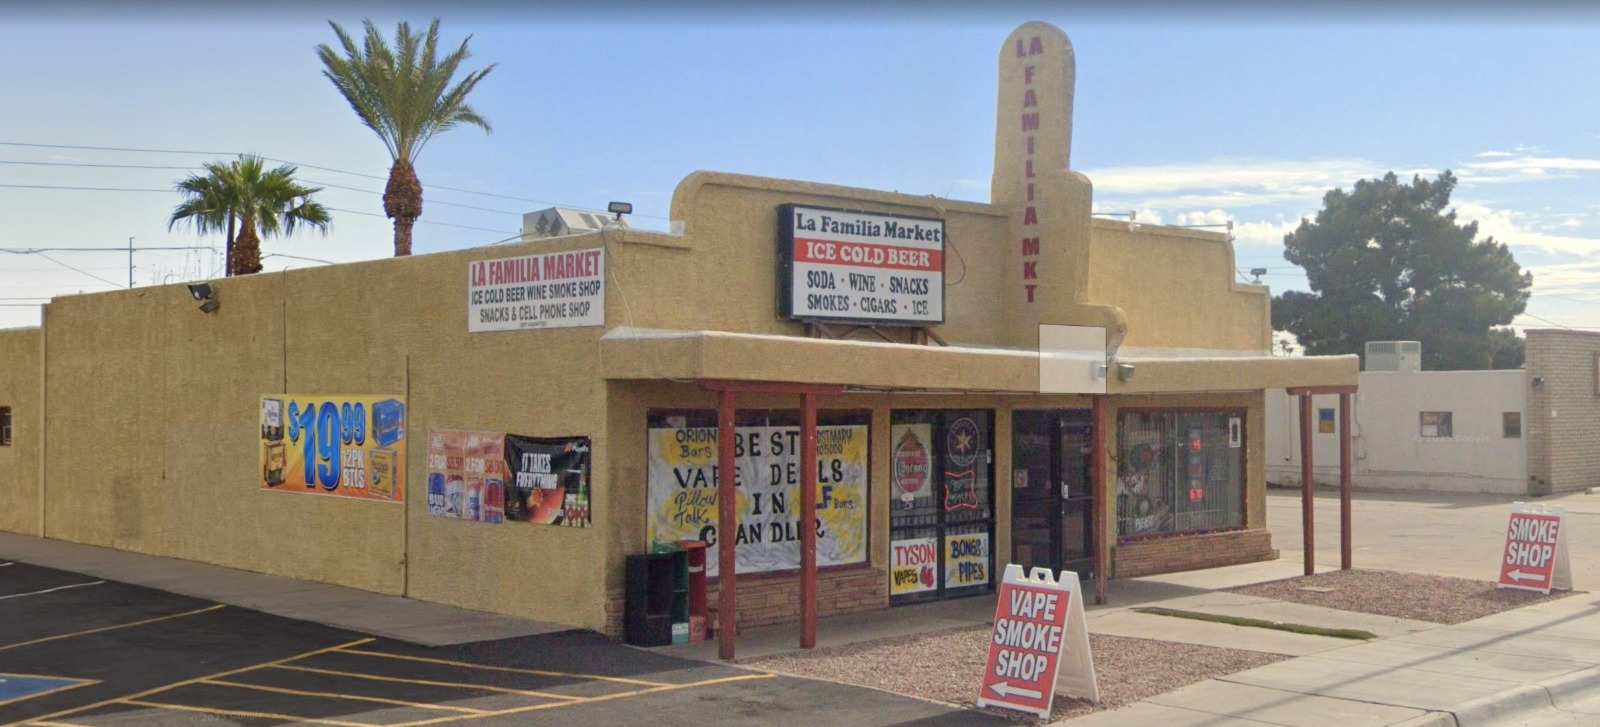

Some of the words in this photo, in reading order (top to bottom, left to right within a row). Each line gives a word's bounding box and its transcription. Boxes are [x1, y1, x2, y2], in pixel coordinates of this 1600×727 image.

[1016, 36, 1043, 58] LA
[1021, 65, 1040, 225] FAMILIA
[796, 212, 817, 232] La
[820, 215, 881, 238] Familia
[884, 220, 941, 242] Market
[806, 241, 837, 261] ICE
[840, 245, 885, 265] COLD
[887, 248, 930, 267] BEER
[472, 261, 487, 287] LA
[489, 257, 541, 286] FAMILIA
[543, 250, 601, 280] MARKET
[1021, 237, 1041, 303] MKT
[471, 290, 483, 306] ICE
[484, 289, 504, 304] COLD
[506, 286, 526, 302] BEER
[527, 284, 547, 301] WINE
[549, 281, 577, 300] SMOKE
[578, 280, 601, 297] SHOP
[807, 270, 836, 290] SODA
[849, 272, 876, 293] WINE
[889, 276, 929, 295] SNACKS
[480, 306, 510, 323] SNACKS
[511, 306, 517, 321] &
[518, 305, 538, 320] CELL
[540, 303, 567, 320] PHONE
[568, 301, 591, 317] SHOP
[807, 294, 850, 312] SMOKES
[860, 297, 897, 314] CIGARS
[912, 300, 929, 316] ICE
[675, 429, 717, 444] ORION
[735, 431, 800, 458] BEST
[343, 449, 365, 470] 12PK
[434, 455, 447, 469] FOR
[680, 444, 713, 458] Bars
[466, 458, 471, 472] 2
[471, 458, 484, 473] FOR
[522, 453, 529, 471] IT
[530, 453, 551, 473] TAKES
[769, 459, 844, 486] DELS
[343, 467, 365, 489] BTLS
[516, 471, 558, 490] EVERYTHING
[429, 494, 444, 506] BUD
[674, 491, 718, 511] Pillow
[752, 492, 785, 515] IN
[834, 499, 854, 510] Bars
[674, 508, 710, 528] Talk
[1509, 517, 1558, 544] SMOKE
[894, 541, 936, 567] TYSON
[950, 538, 982, 559] BONGS
[1506, 541, 1553, 568] SHOP
[893, 569, 918, 587] VAPES
[958, 561, 985, 583] PIPES
[1011, 589, 1058, 621] VAPE
[994, 618, 1062, 653] SMOKE
[995, 649, 1048, 682] SHOP
